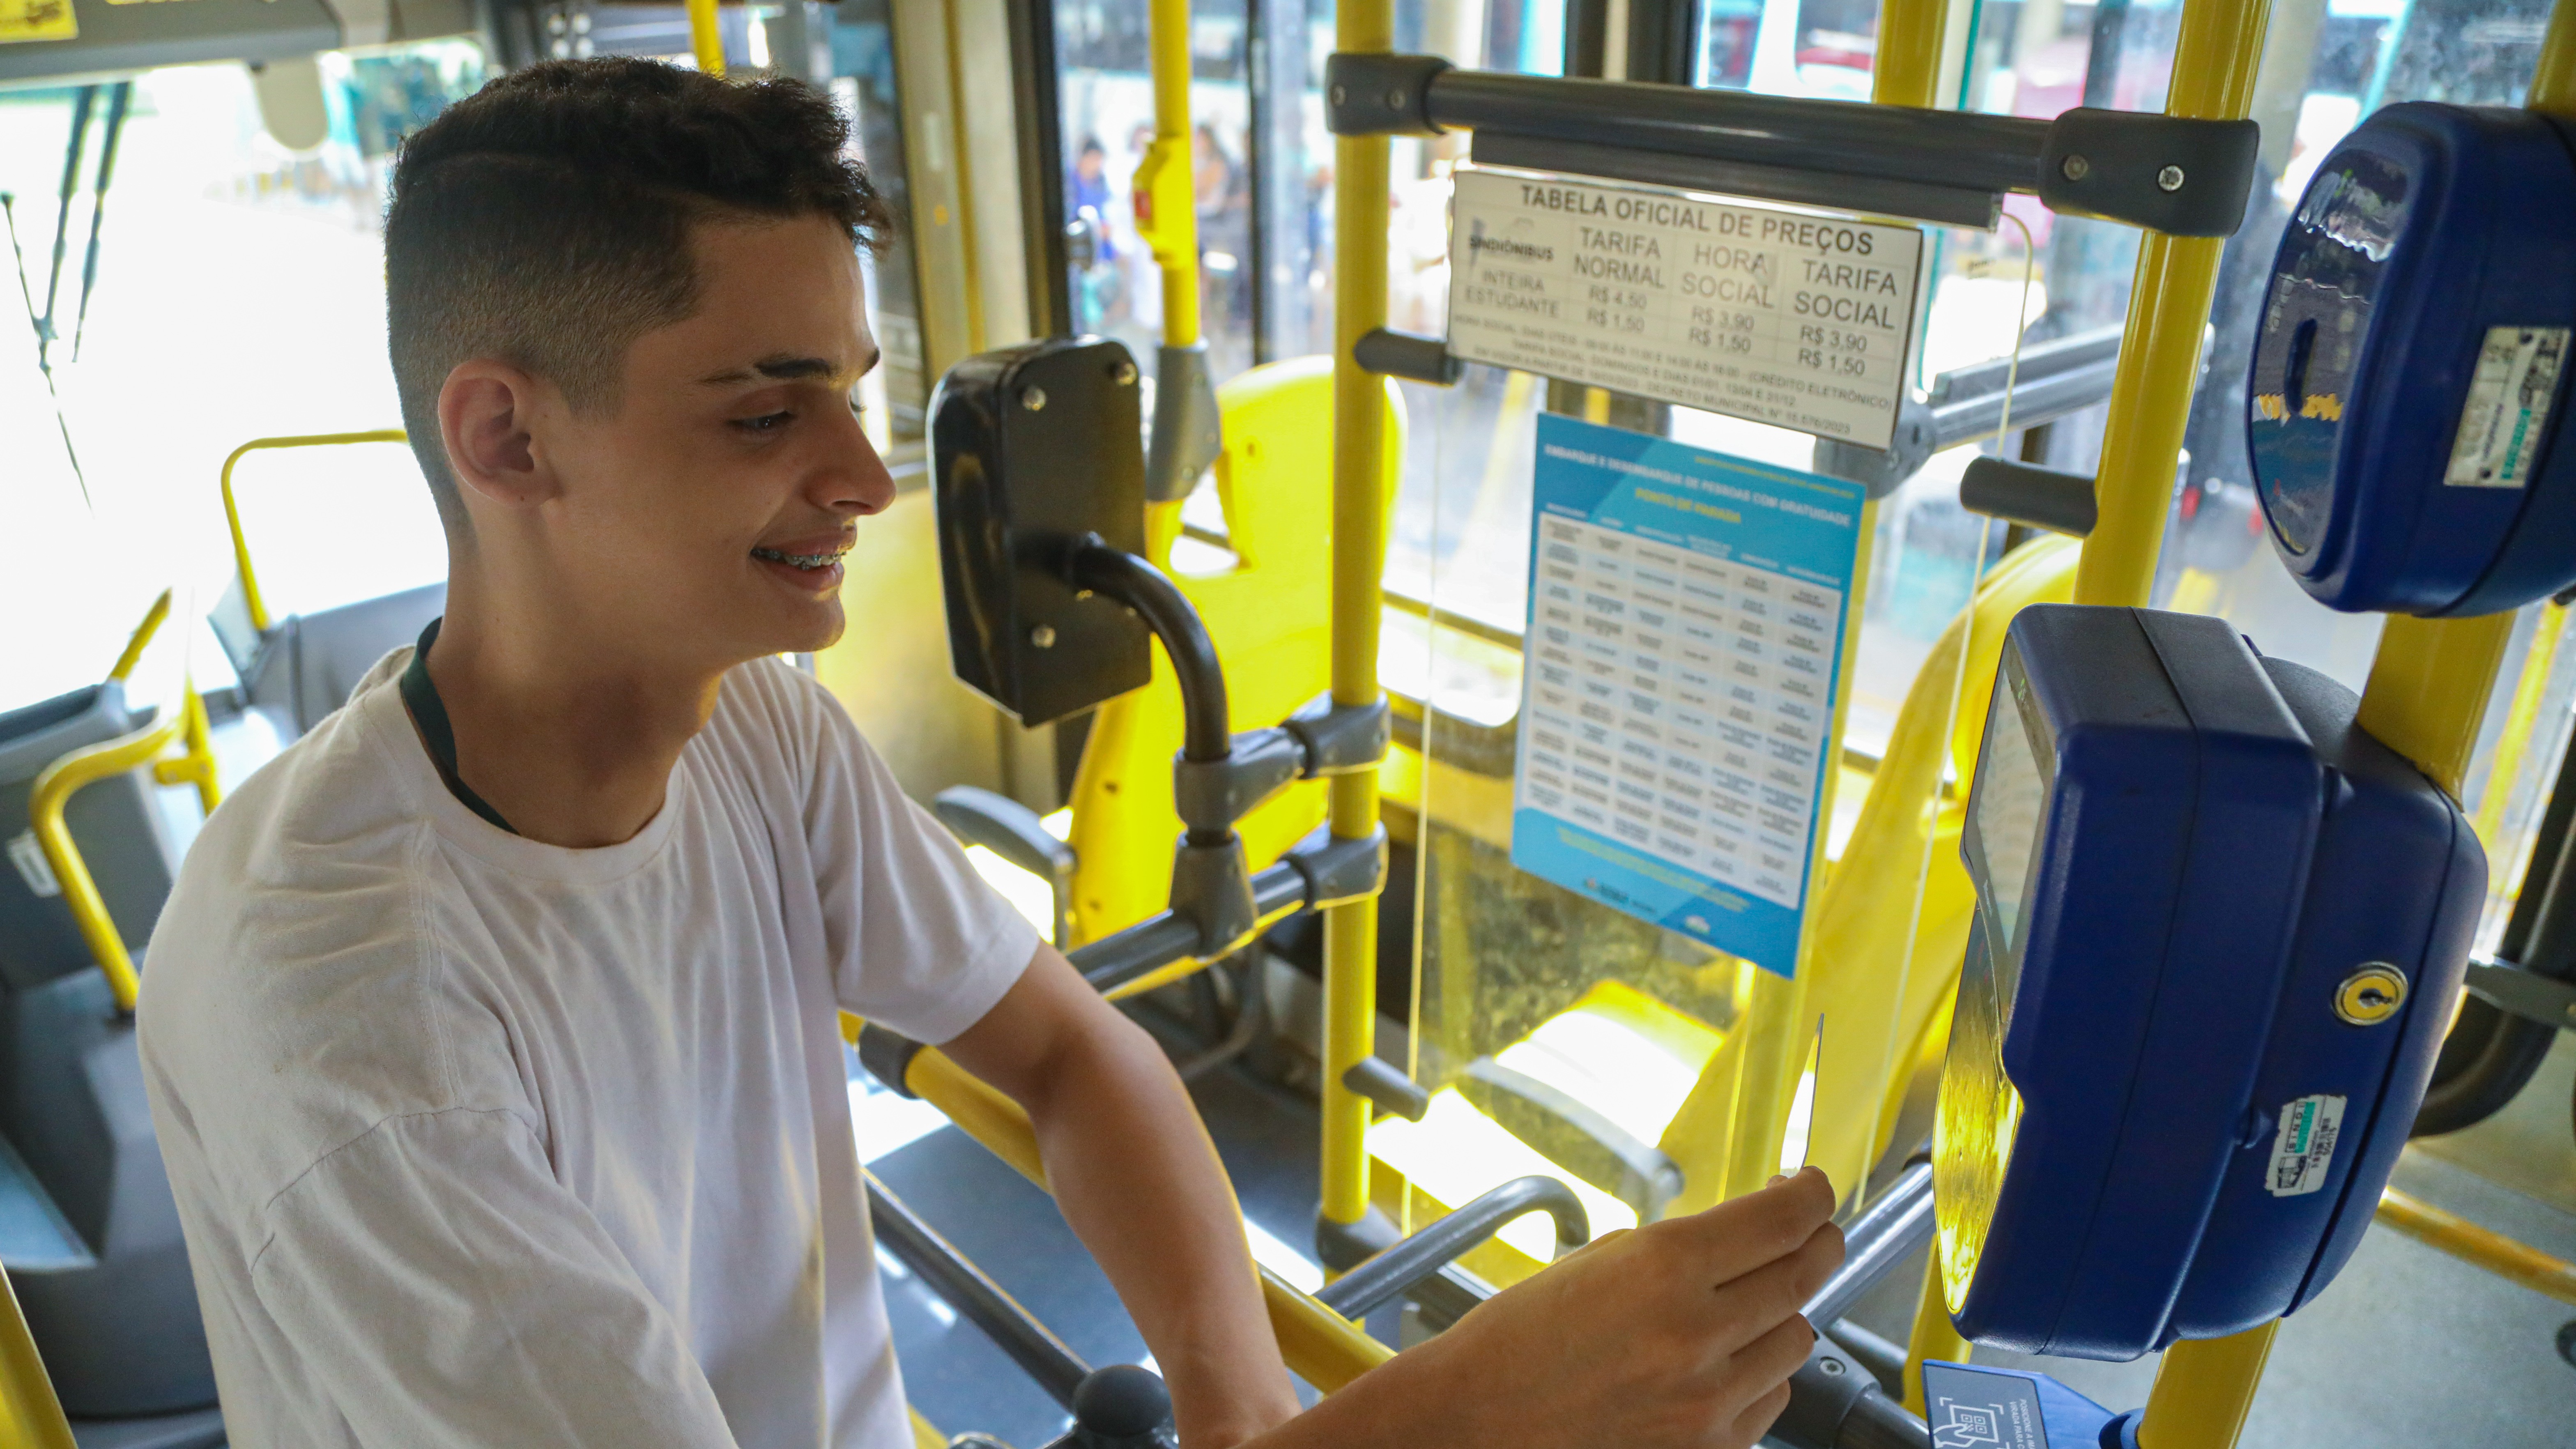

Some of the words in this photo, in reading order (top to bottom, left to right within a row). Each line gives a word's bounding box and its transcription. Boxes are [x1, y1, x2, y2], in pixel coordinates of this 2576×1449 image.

[1522, 184, 1608, 217] TABELA
[1615, 198, 1711, 232] OFICIAL
[1719, 211, 1753, 237] DE
[1761, 217, 1874, 256] PREÇOS
[1580, 226, 1661, 260] TARIFA
[1574, 253, 1666, 289] NORMAL
[1693, 243, 1768, 274] HORA
[1483, 270, 1545, 292] INTEIRA
[1681, 272, 1777, 309] SOCIAL
[1803, 259, 1897, 297] TARIFA
[1465, 285, 1558, 317] ESTUDANTE
[1589, 284, 1609, 304] R$
[1587, 307, 1607, 327] R$
[1692, 305, 1715, 325] R$
[1794, 291, 1896, 330] SOCIAL
[1689, 326, 1711, 347] R$
[1800, 324, 1824, 345] R$
[1831, 329, 1867, 353] 3,90
[1798, 347, 1822, 368] R$
[1830, 354, 1865, 376] 1,50
[1703, 393, 1767, 416] MUNICIPAL
